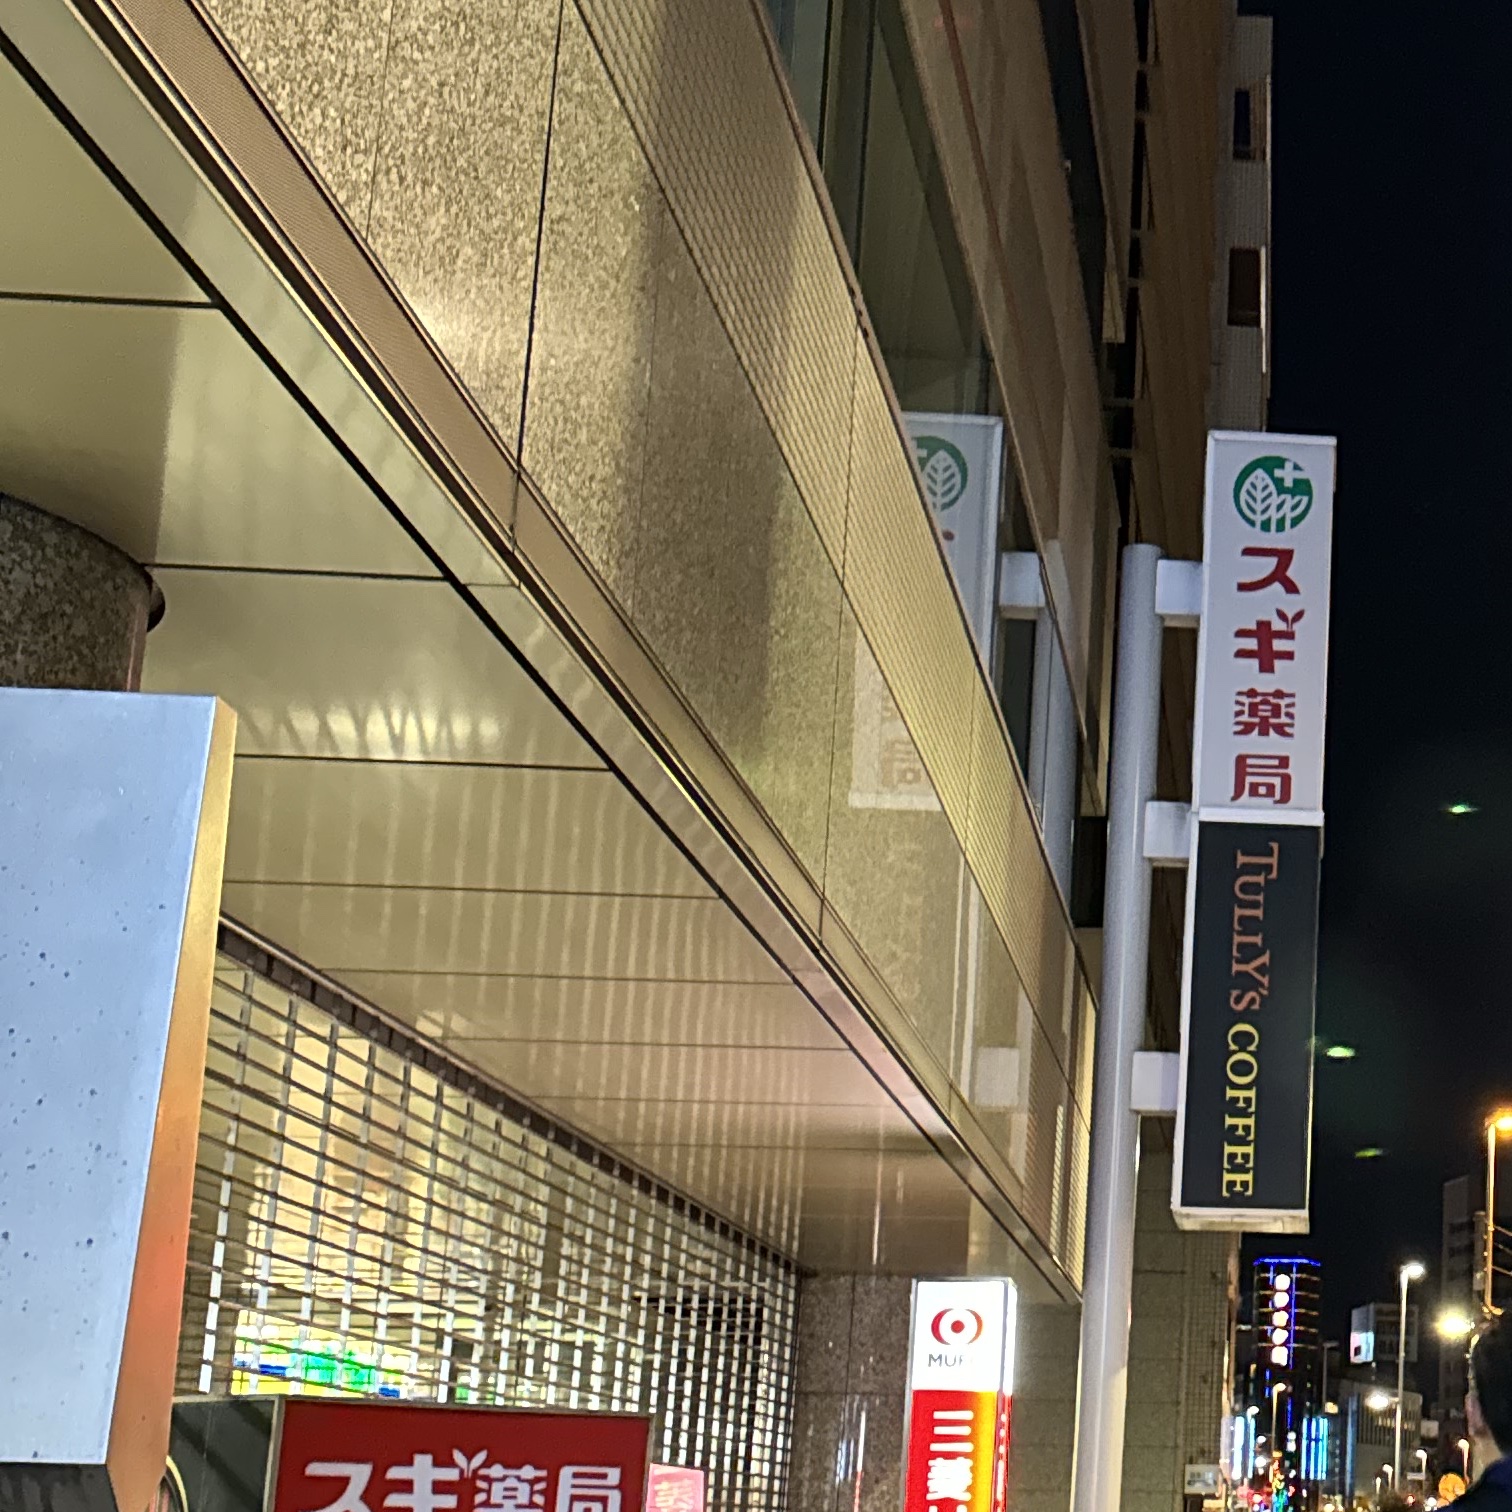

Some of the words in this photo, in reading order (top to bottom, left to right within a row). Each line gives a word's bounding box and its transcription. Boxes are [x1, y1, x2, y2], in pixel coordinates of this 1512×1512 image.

[1230, 545, 1306, 805] スギ薬局
[1222, 1022, 1260, 1198] COFFEE
